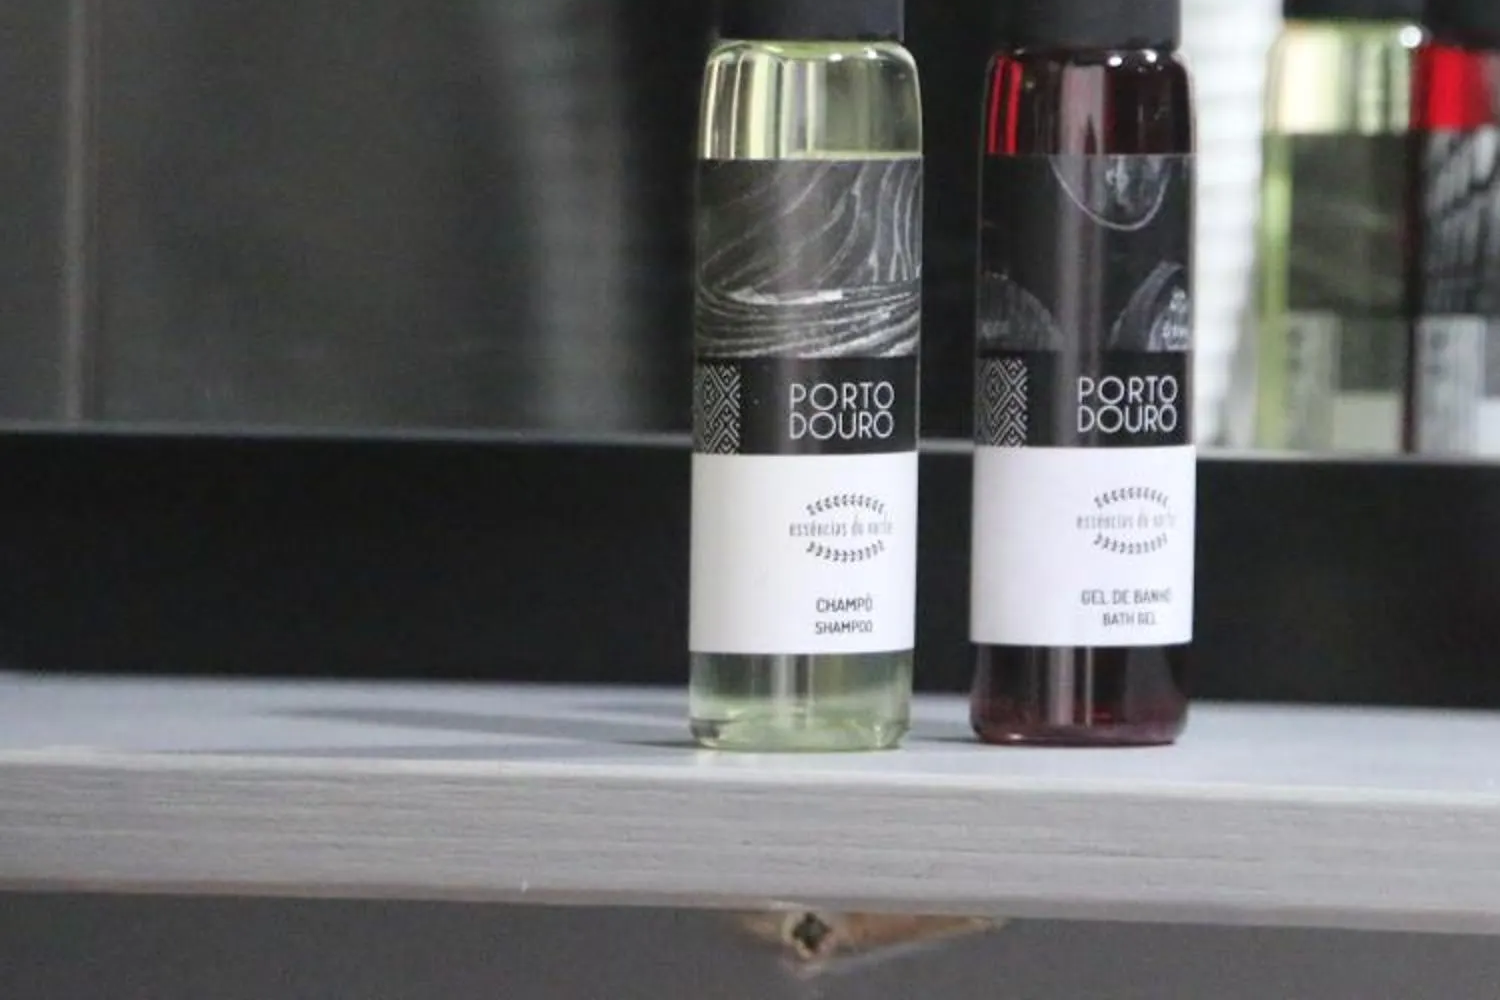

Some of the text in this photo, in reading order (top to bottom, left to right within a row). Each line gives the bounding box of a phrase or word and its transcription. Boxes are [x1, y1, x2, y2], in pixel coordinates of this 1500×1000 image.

[790, 381, 895, 411] PORTO
[1078, 375, 1178, 404] PORTO
[789, 411, 895, 440] DOURO
[1077, 403, 1178, 433] DOURO
[1081, 588, 1108, 605] GEL
[1111, 588, 1131, 605] DE
[815, 619, 873, 635] SHAMPOO
[1103, 611, 1158, 626] BATH GEL
